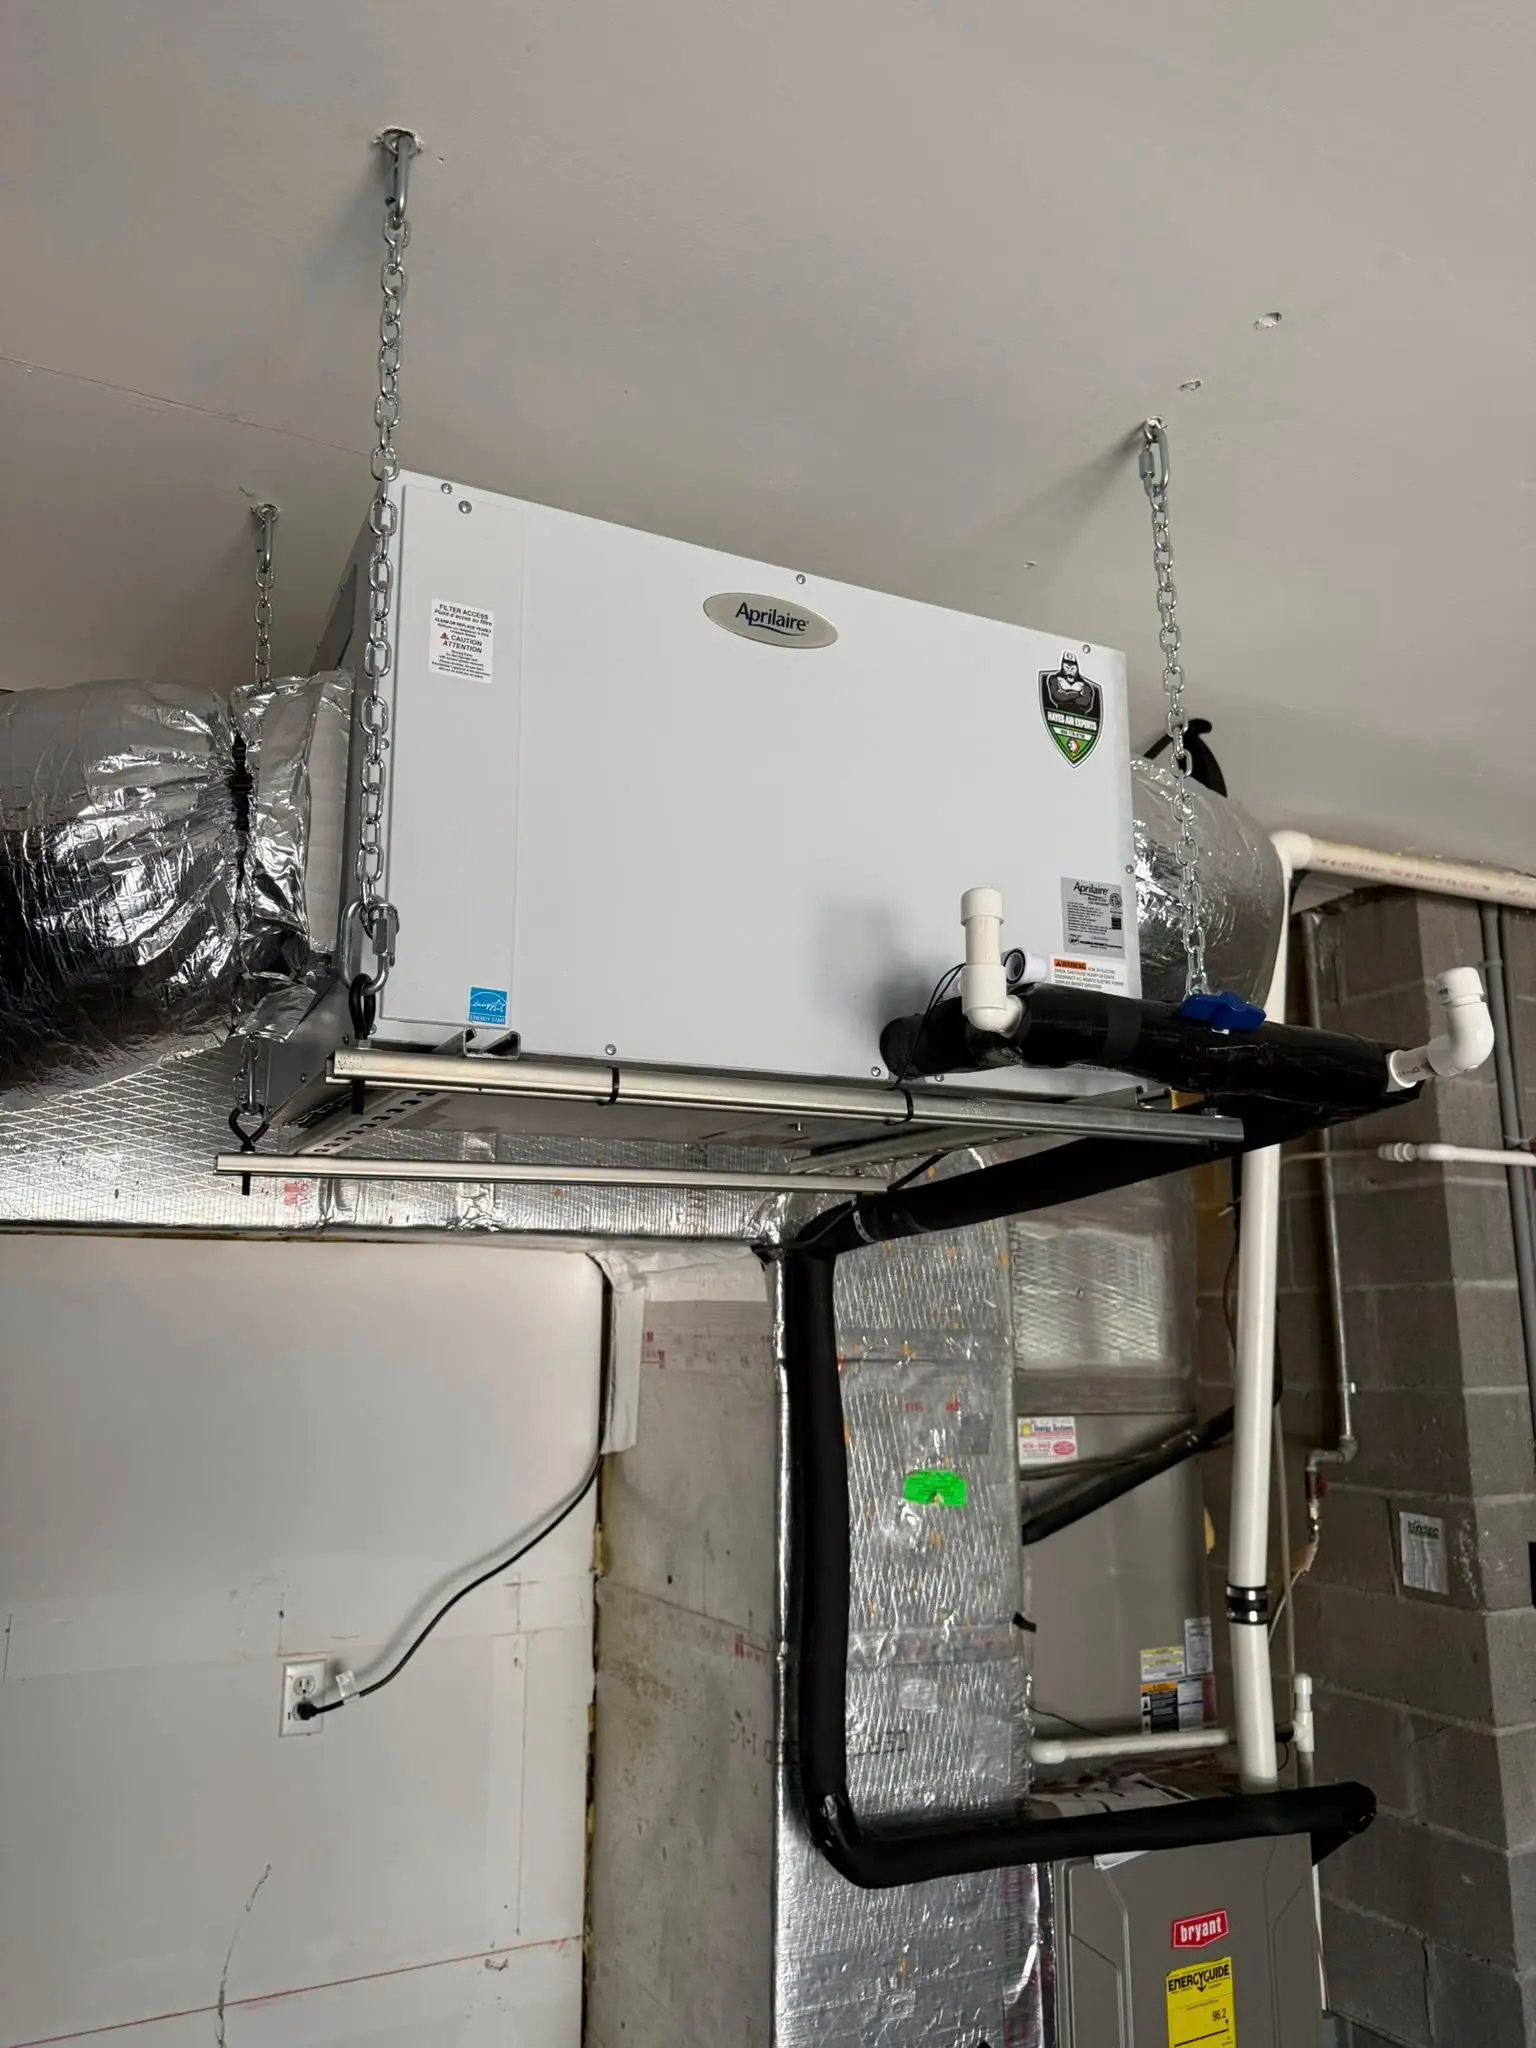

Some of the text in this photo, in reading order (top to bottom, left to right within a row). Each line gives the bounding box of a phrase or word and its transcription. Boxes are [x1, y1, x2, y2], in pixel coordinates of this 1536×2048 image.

[439, 603, 489, 621] FILTER ACCESS
[735, 602, 808, 633] Aprilaire
[442, 640, 483, 654] ATTENTION
[450, 634, 482, 647] CAUTION
[1065, 715, 1075, 726] AIR
[1073, 881, 1109, 896] Aprilaire
[1180, 1916, 1222, 1942] bryant
[1168, 1964, 1230, 1993] ENERGYGUIDE
